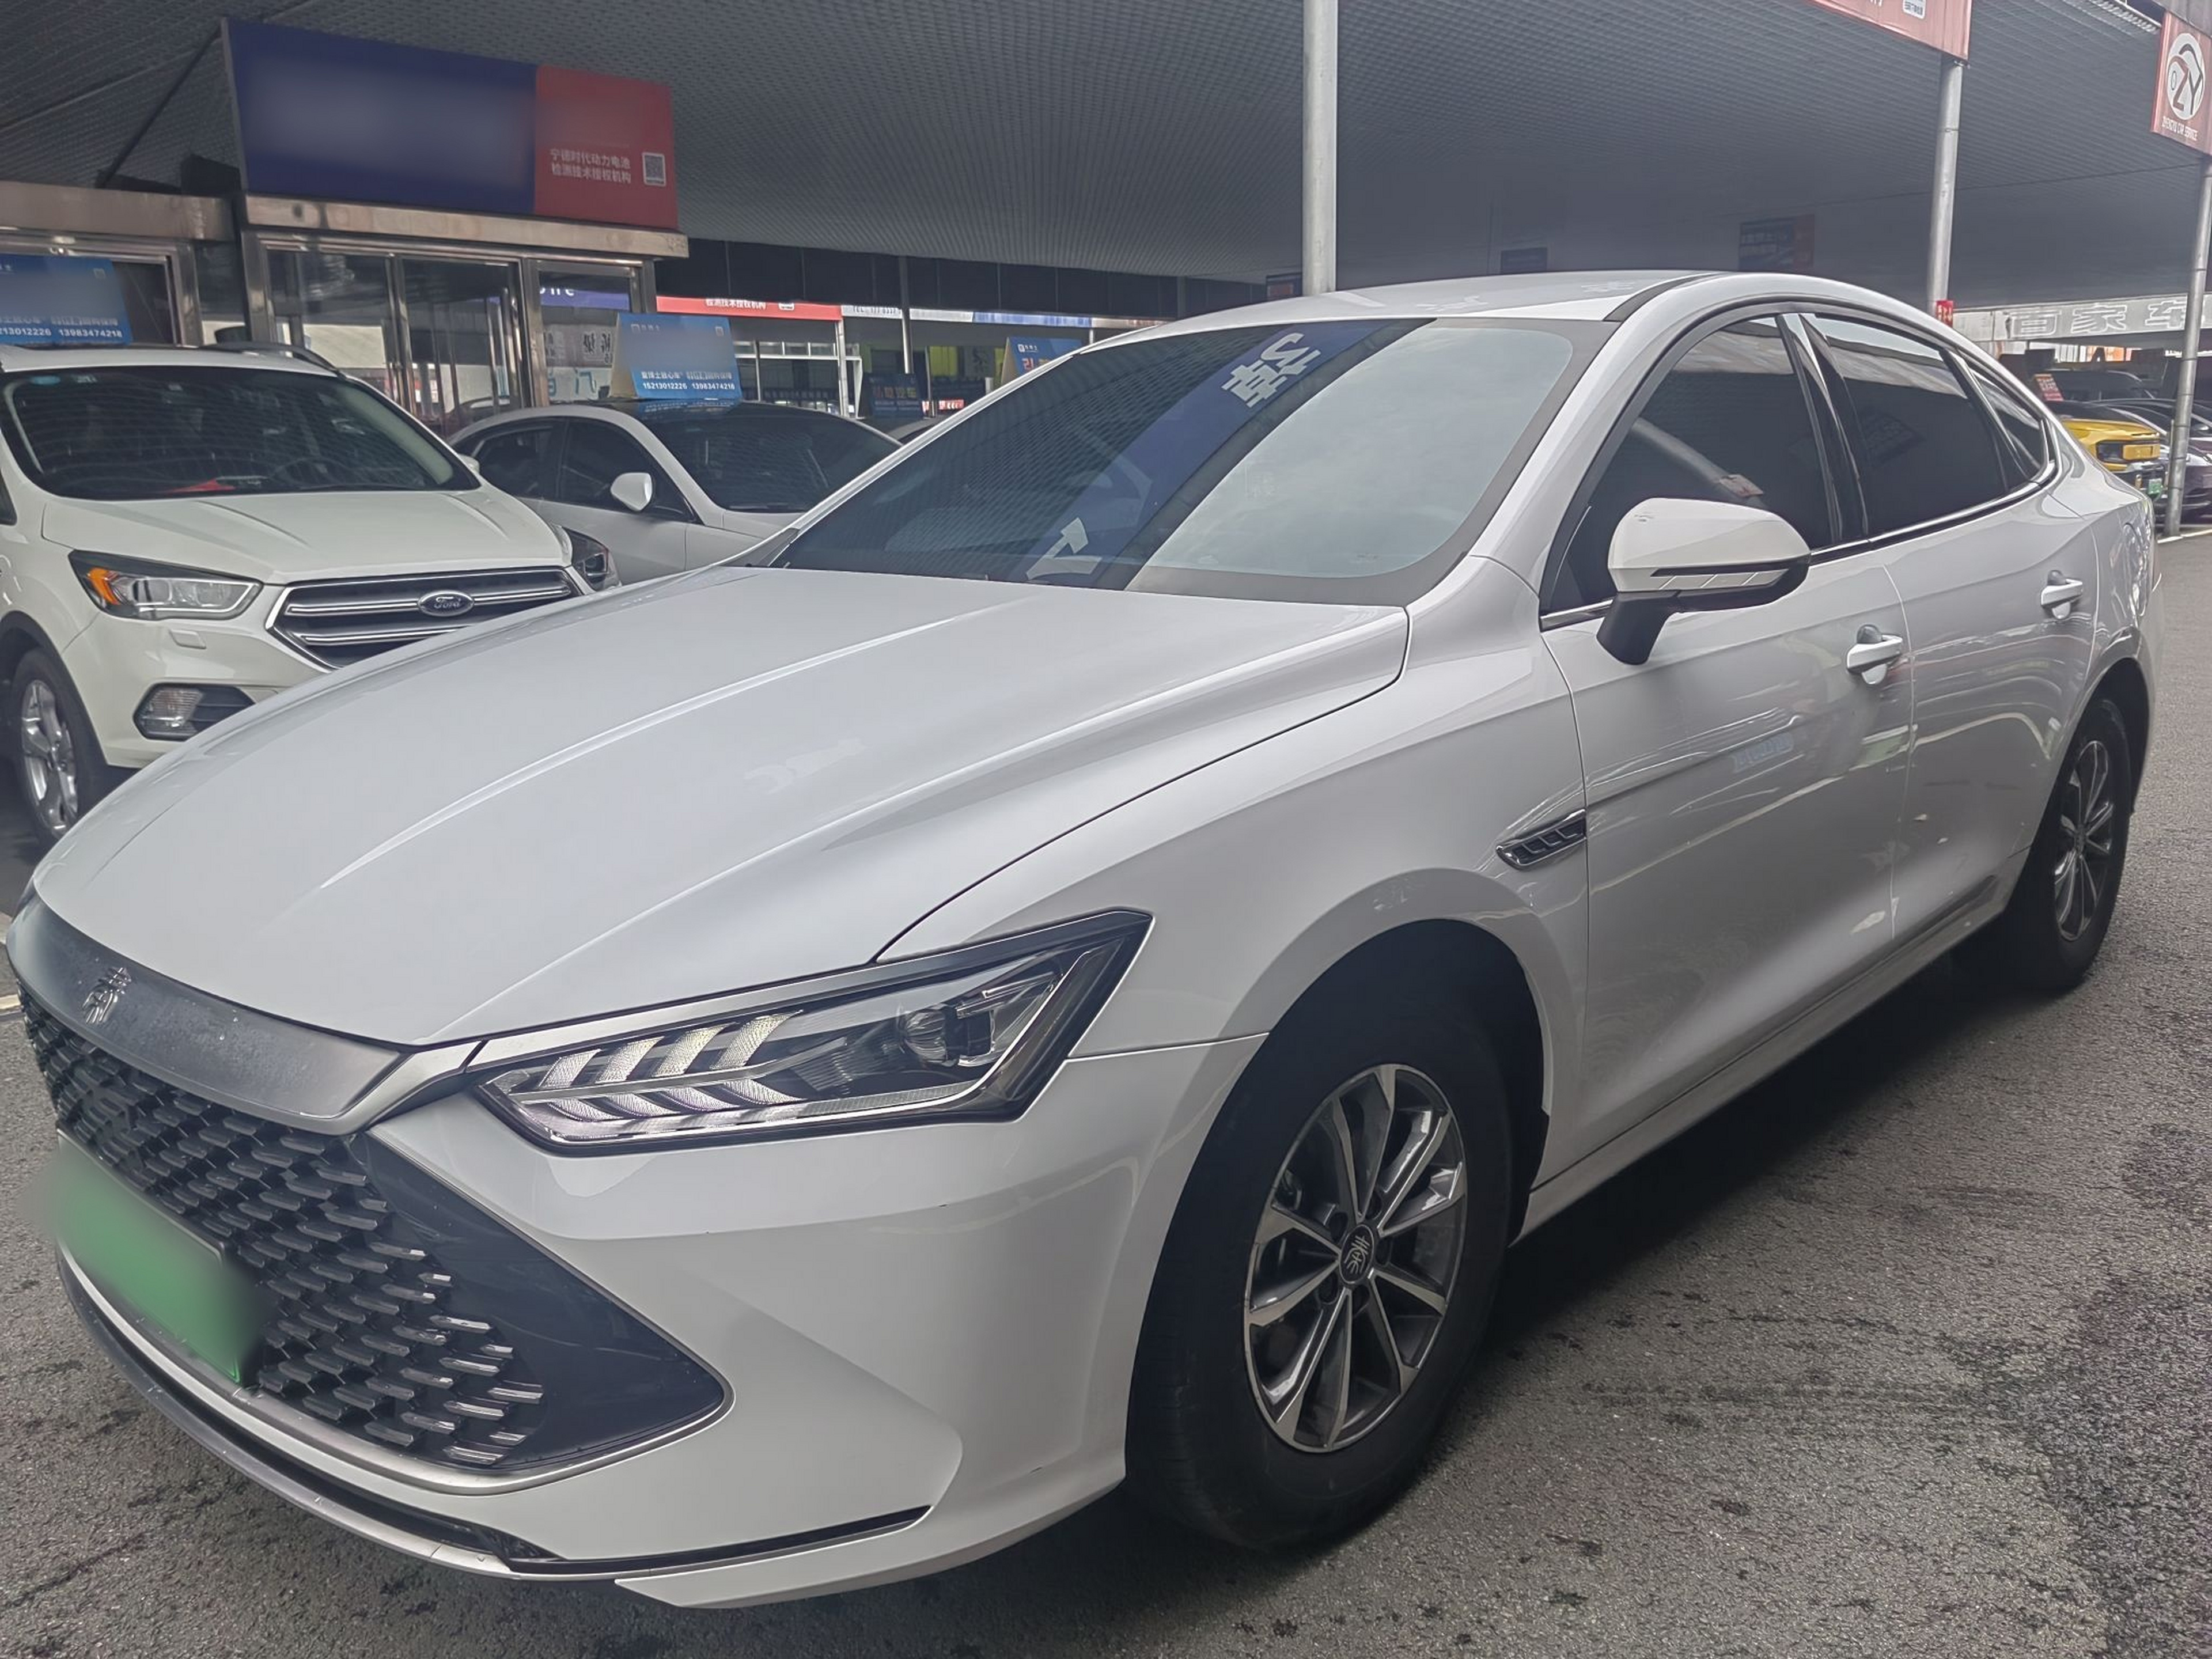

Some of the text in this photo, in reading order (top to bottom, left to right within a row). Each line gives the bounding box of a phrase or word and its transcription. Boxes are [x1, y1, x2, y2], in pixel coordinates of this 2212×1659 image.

[550, 148, 631, 169] 宁德时代动力电池
[59, 329, 122, 338] 13983474218
[433, 596, 461, 609] Ford
